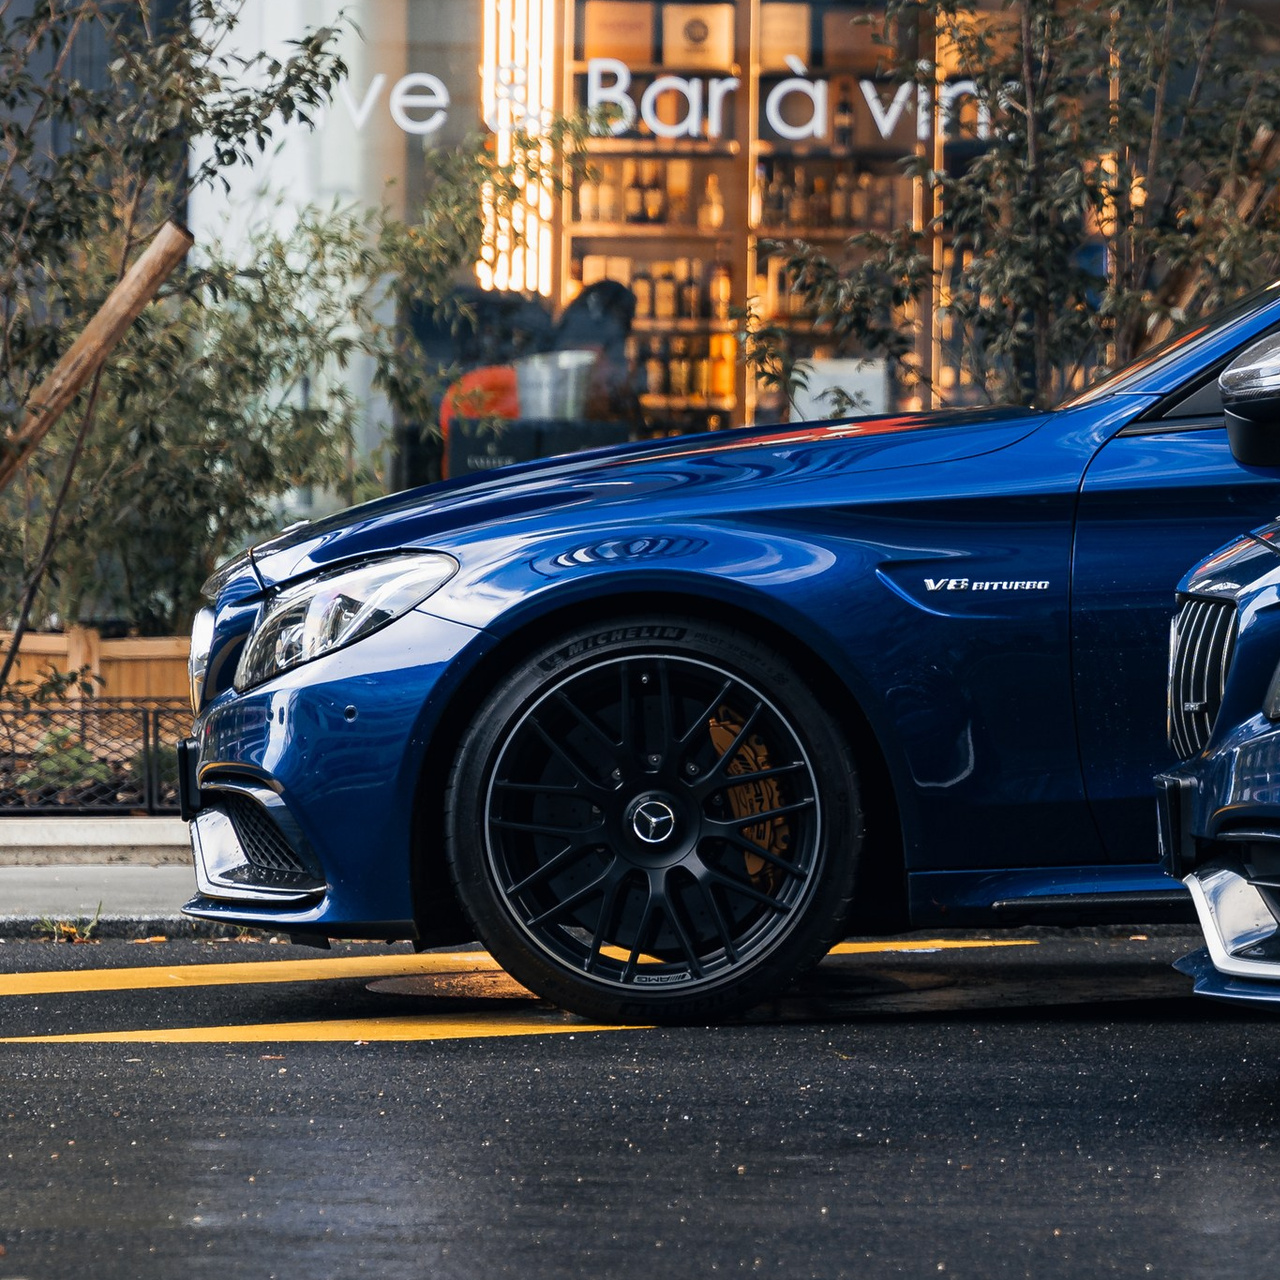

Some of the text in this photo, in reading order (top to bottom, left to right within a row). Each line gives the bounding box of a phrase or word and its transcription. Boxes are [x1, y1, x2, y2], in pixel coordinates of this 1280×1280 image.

[587, 58, 739, 139] Bar
[766, 53, 829, 140] à
[924, 577, 1050, 591] V8 BITURBO
[567, 626, 682, 657] MICHELIN
